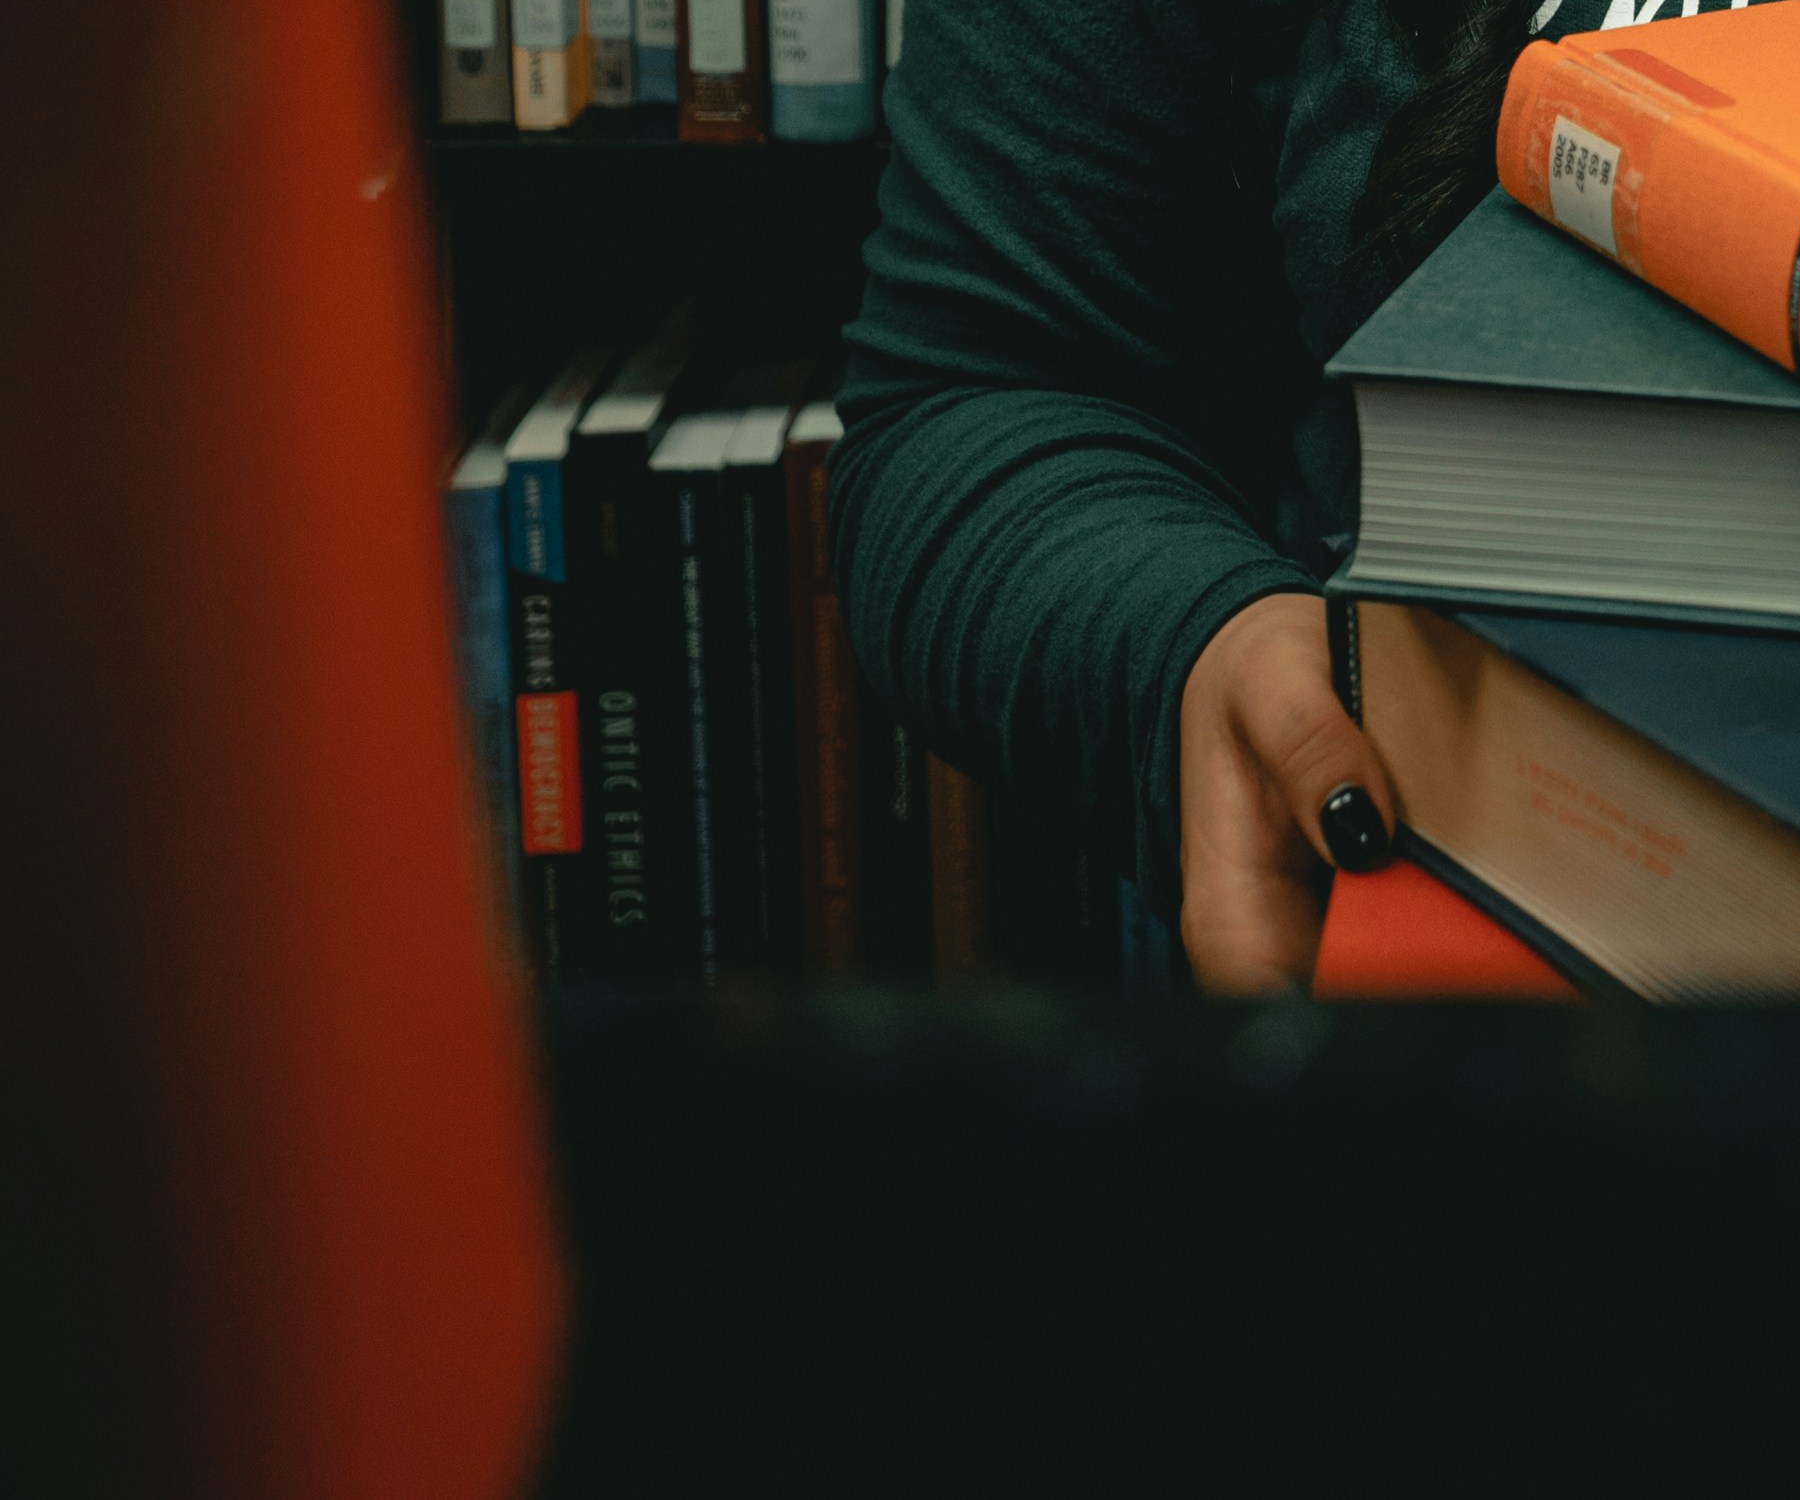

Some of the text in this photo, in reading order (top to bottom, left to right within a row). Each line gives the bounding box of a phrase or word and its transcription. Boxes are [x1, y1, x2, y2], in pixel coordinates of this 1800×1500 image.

[1554, 132, 1568, 180] 2005
[1565, 138, 1579, 178] A66
[1576, 146, 1591, 194] P287
[1588, 152, 1601, 179] 65
[1600, 159, 1612, 187] BR
[523, 594, 564, 849] CARING DEMOCRACY
[600, 689, 648, 928] ONTIC ETHICS
